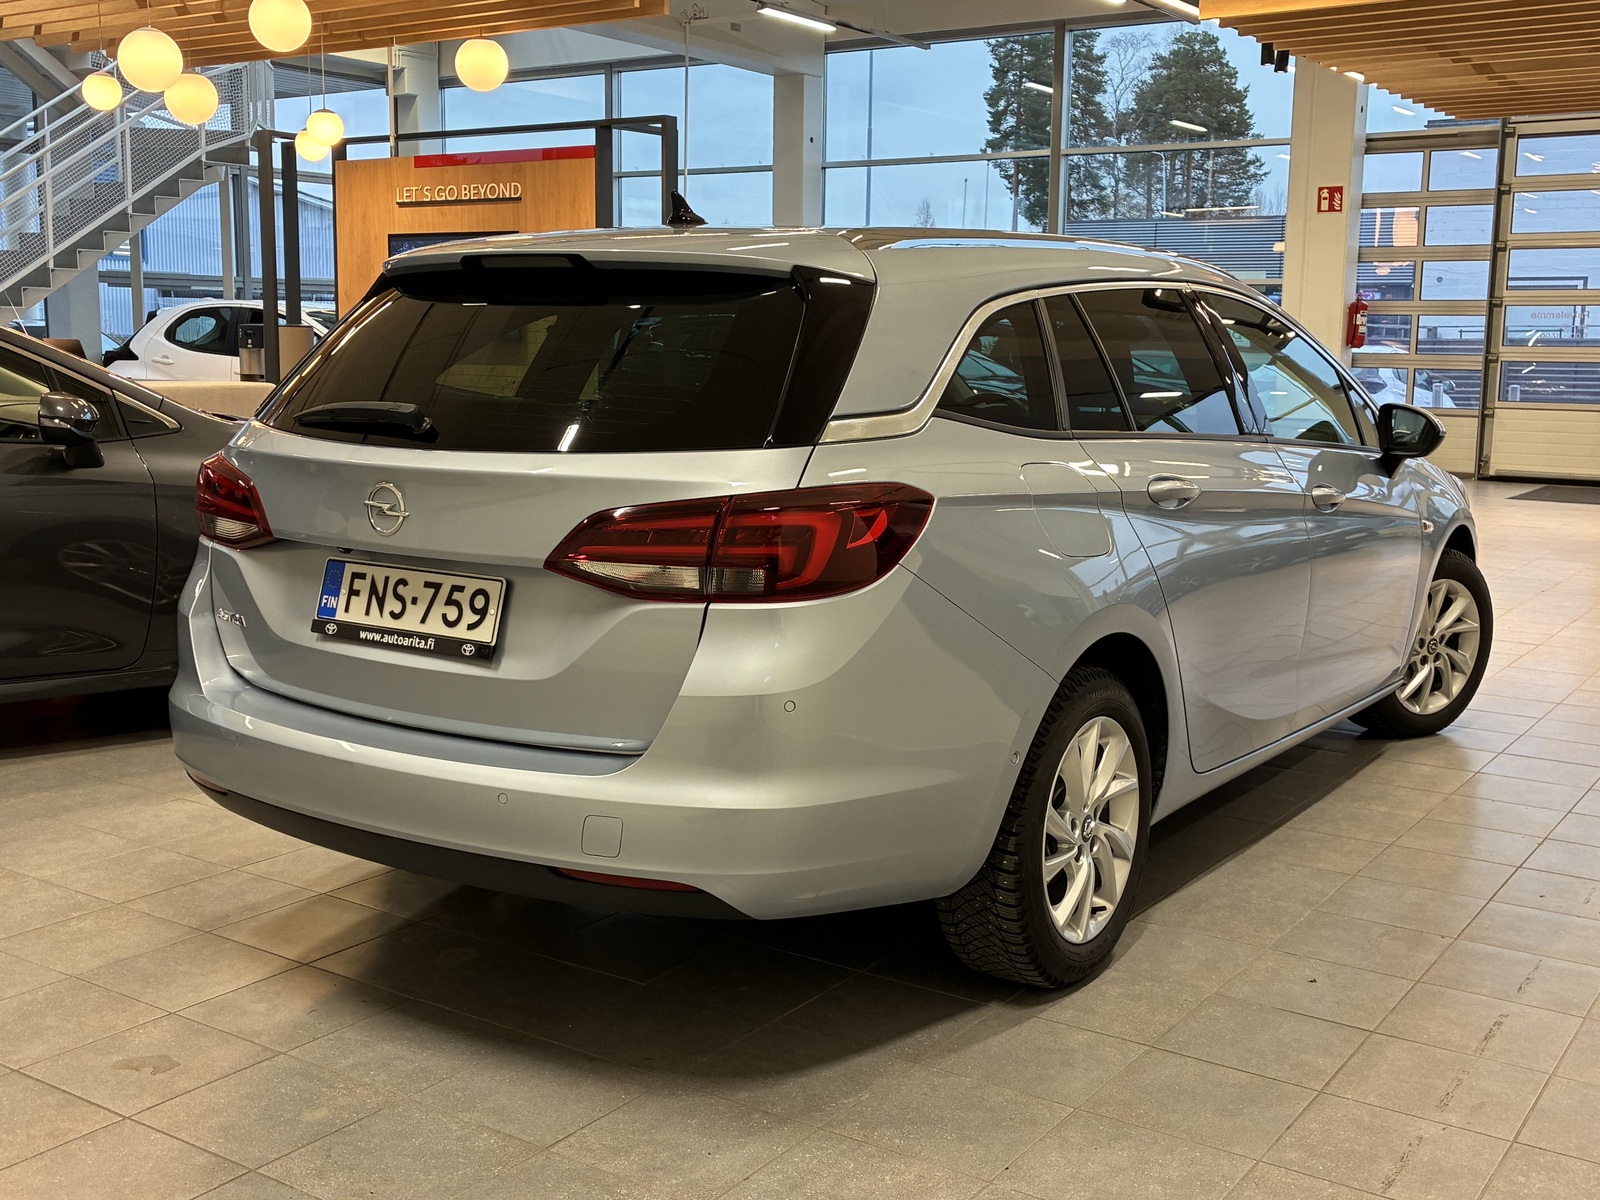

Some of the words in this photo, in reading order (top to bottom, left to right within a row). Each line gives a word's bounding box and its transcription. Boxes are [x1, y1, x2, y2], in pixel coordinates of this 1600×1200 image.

[434, 185, 458, 200] GO
[461, 182, 521, 200] BEYOND
[321, 595, 338, 609] FIN
[359, 629, 435, 651] www.autoarita.fi
